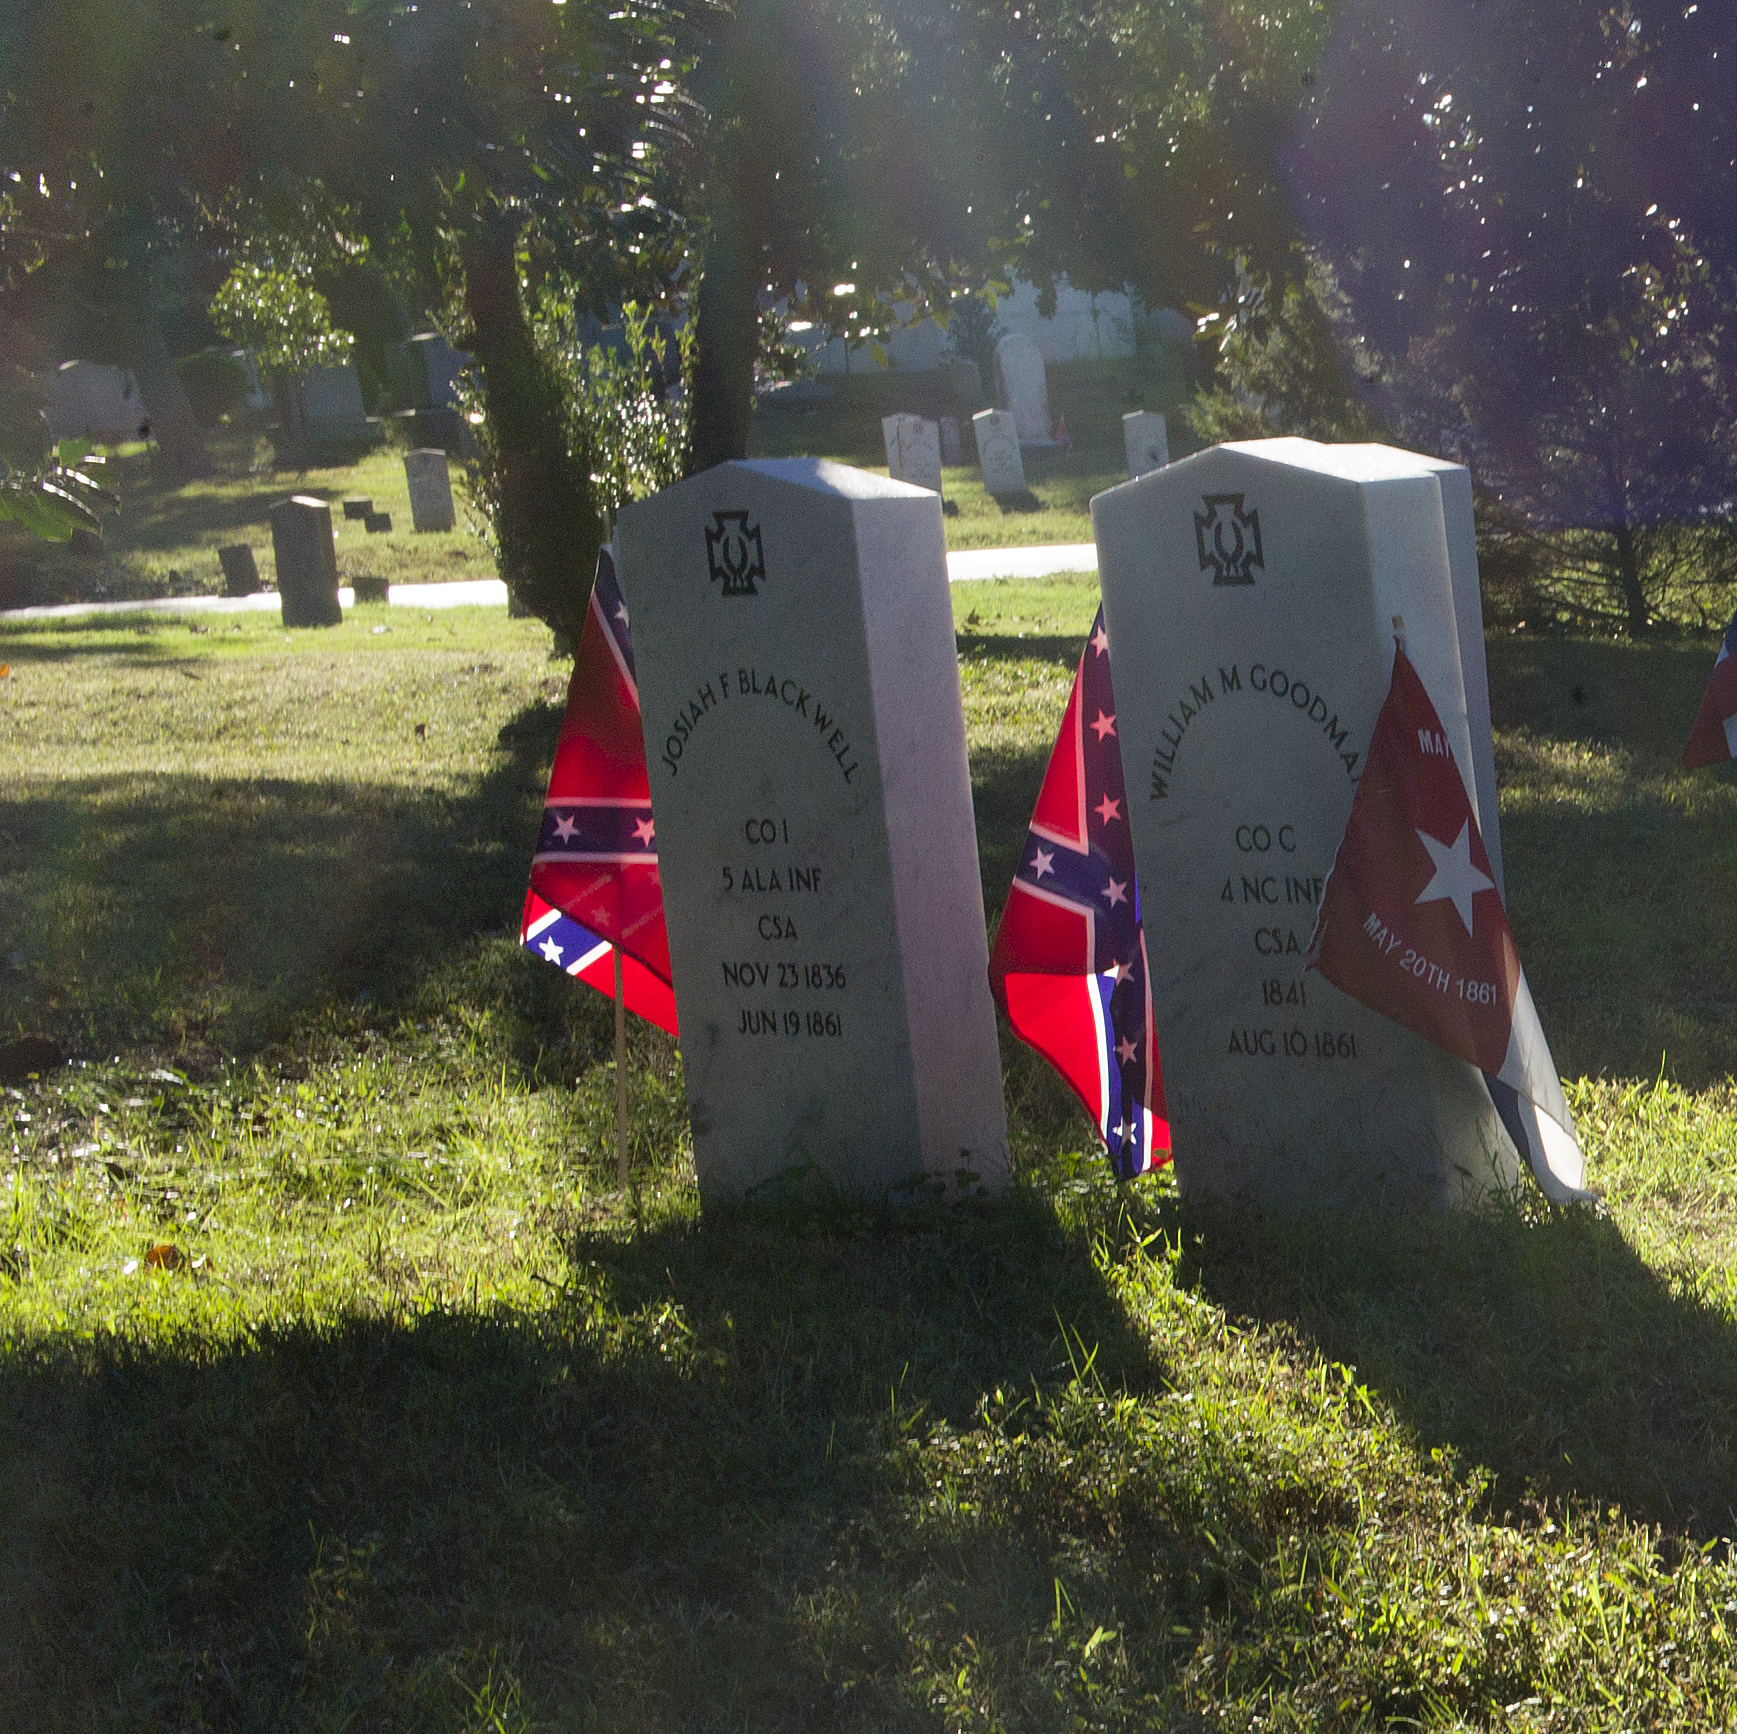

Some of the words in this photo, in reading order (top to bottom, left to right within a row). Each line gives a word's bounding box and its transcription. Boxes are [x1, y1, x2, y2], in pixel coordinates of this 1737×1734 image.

[662, 683, 718, 776] JOSIAH
[719, 672, 730, 698] F
[738, 668, 859, 785] BLACKWELL
[1151, 676, 1215, 800] WILLIAM
[1219, 664, 1243, 694] M
[1250, 664, 1361, 782] GOODMA
[745, 818, 776, 845] CO
[783, 818, 789, 843] I
[1236, 824, 1271, 852] CO
[1278, 824, 1297, 852] C
[722, 866, 734, 892] 5
[742, 868, 782, 892] ALA
[788, 867, 821, 892] INF
[1221, 877, 1233, 903] 4
[1242, 876, 1278, 904] NC
[758, 914, 798, 941] CSA
[1255, 926, 1301, 955] CSA
[1363, 912, 1402, 956] MAY
[1400, 949, 1450, 993] 20TH
[1456, 979, 1498, 1006] 1861
[721, 961, 769, 988] NOV
[777, 962, 799, 989] 23
[804, 962, 847, 989] 1836
[1262, 979, 1306, 1006] 1841
[738, 1009, 777, 1036] JUN
[783, 1011, 800, 1037] 19
[806, 1012, 842, 1037] 1861
[1229, 1029, 1276, 1056] AUG
[1283, 1030, 1308, 1057] 10
[1315, 1031, 1357, 1058] 1861
